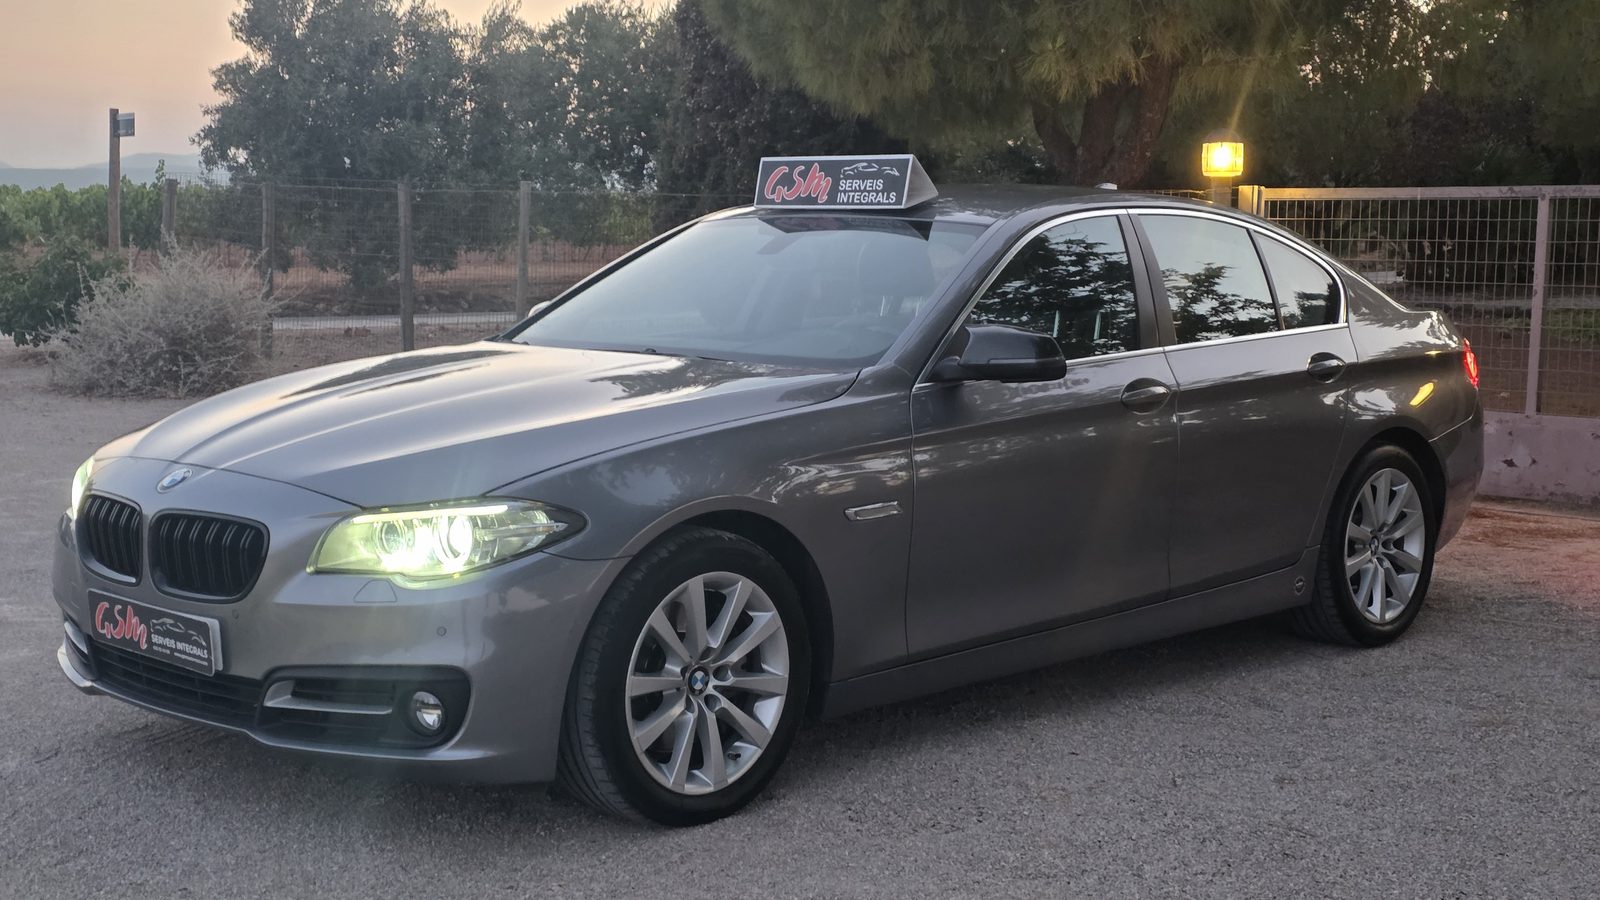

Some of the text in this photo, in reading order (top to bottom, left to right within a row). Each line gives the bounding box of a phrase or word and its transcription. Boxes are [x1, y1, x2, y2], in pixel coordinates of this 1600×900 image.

[838, 179, 884, 191] SERVEIS
[836, 191, 897, 204] INTEGRALS
[151, 633, 176, 649] SERVEIS
[176, 641, 208, 659] INTEGRALS
